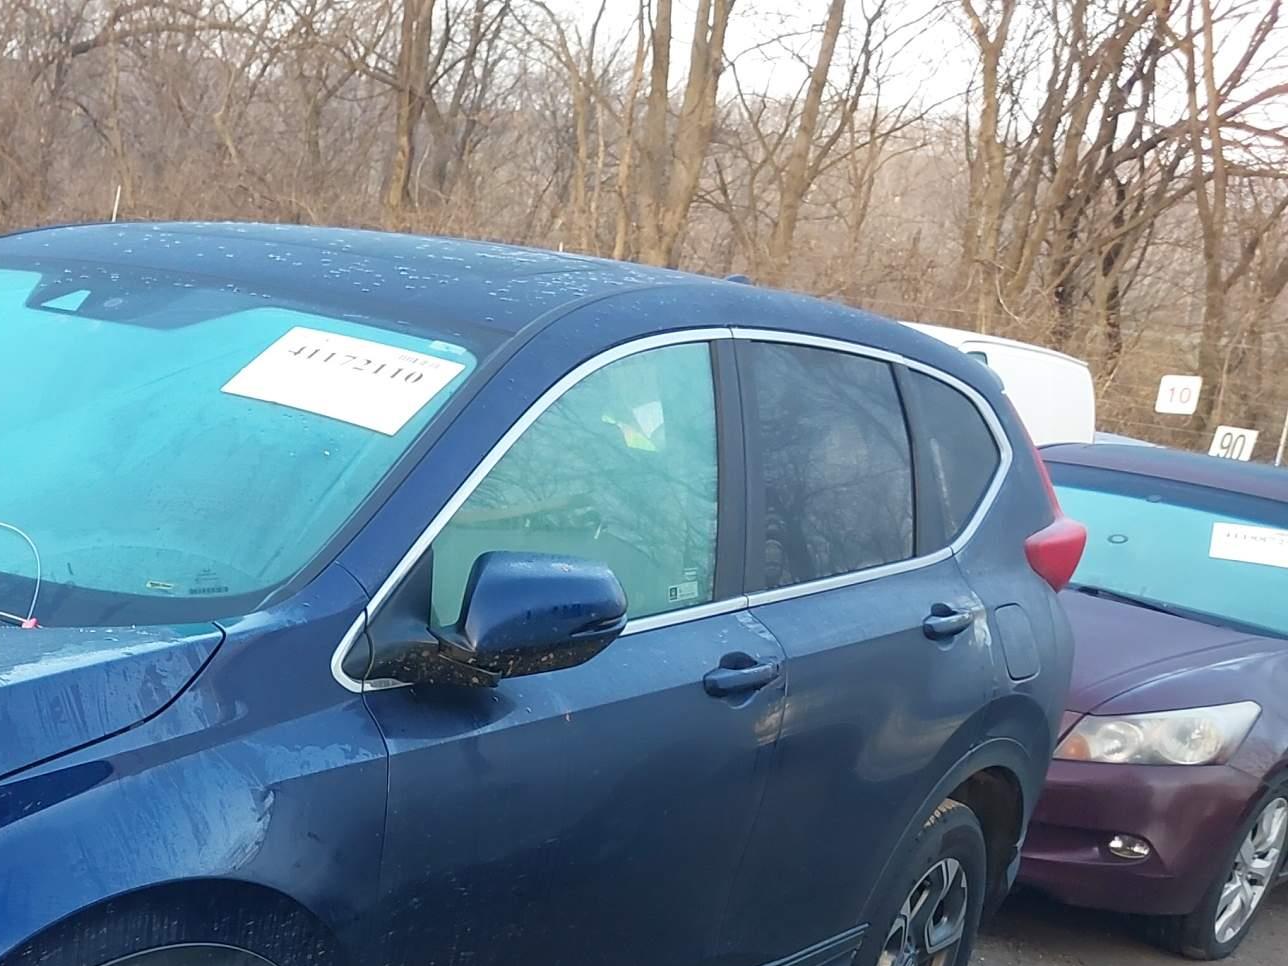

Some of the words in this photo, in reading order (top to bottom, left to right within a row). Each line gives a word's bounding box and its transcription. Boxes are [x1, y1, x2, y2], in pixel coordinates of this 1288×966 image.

[288, 346, 424, 384] 41172110
[1169, 387, 1192, 405] 10
[1220, 432, 1246, 460] 90
